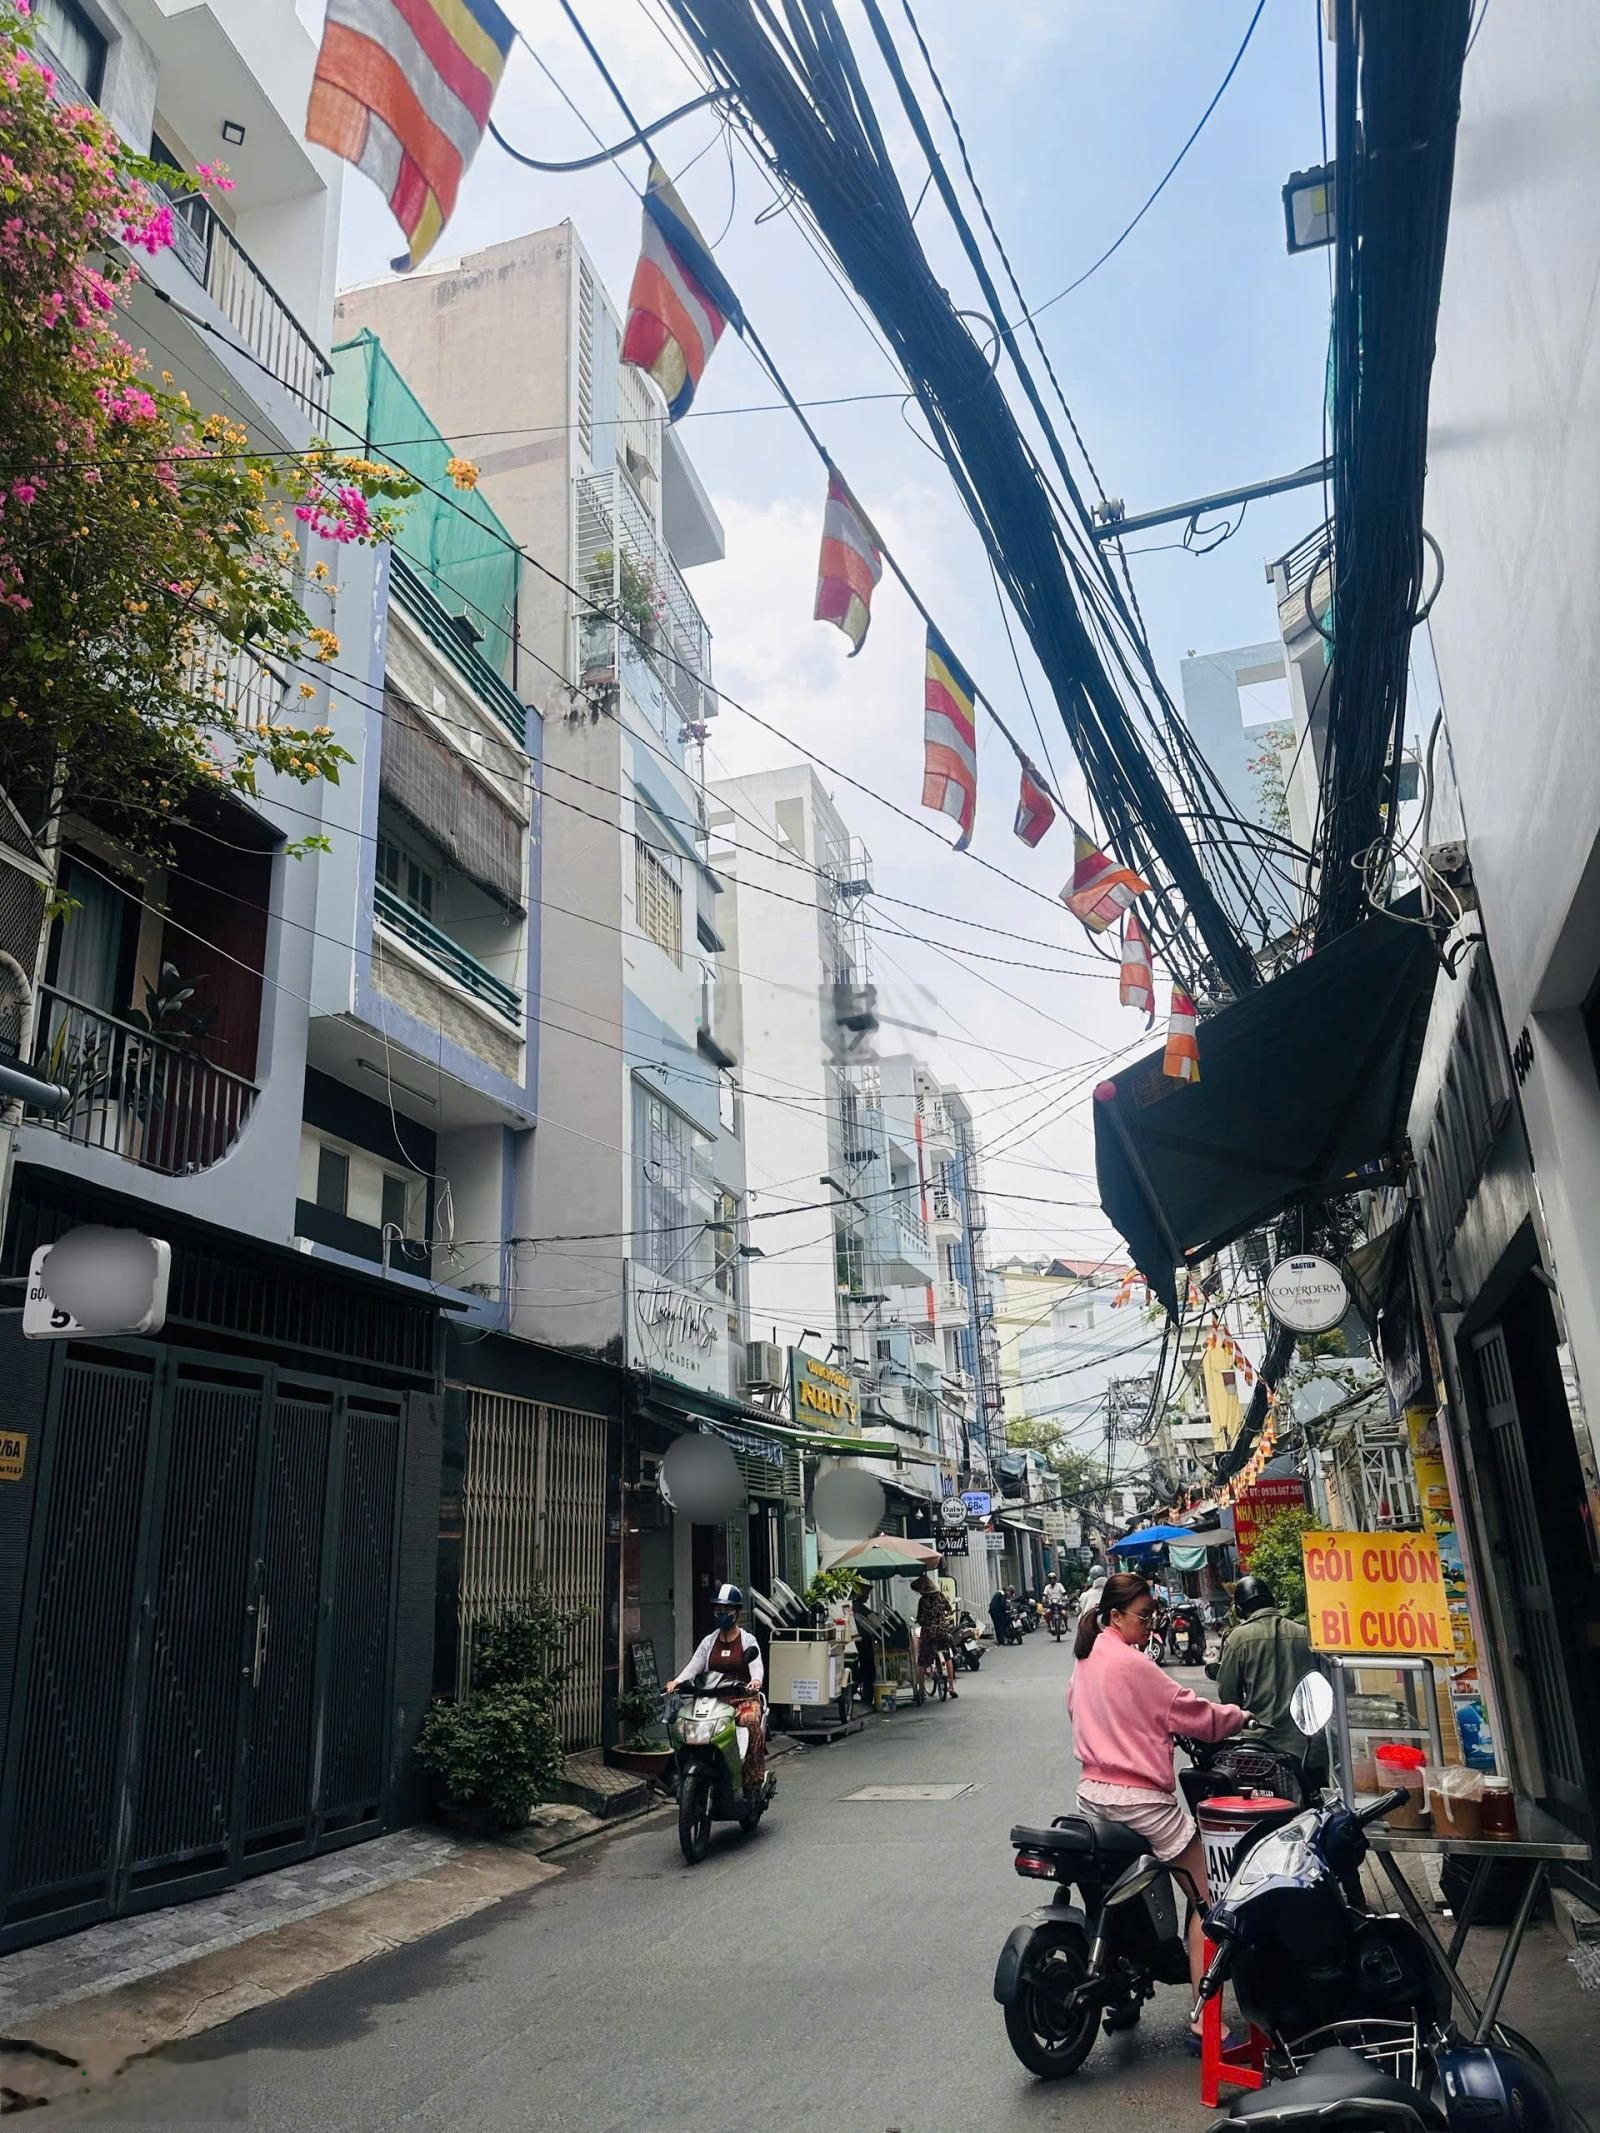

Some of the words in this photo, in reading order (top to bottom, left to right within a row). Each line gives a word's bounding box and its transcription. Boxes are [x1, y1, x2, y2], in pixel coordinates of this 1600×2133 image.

[1271, 1284, 1341, 1297] COVERDERM
[665, 1348, 701, 1373] ACADEMY
[1307, 1537, 1353, 1582] GỎI
[1362, 1538, 1439, 1584] CUỐN
[1321, 1601, 1352, 1646] BÌ
[1359, 1599, 1438, 1648] CUỐN
